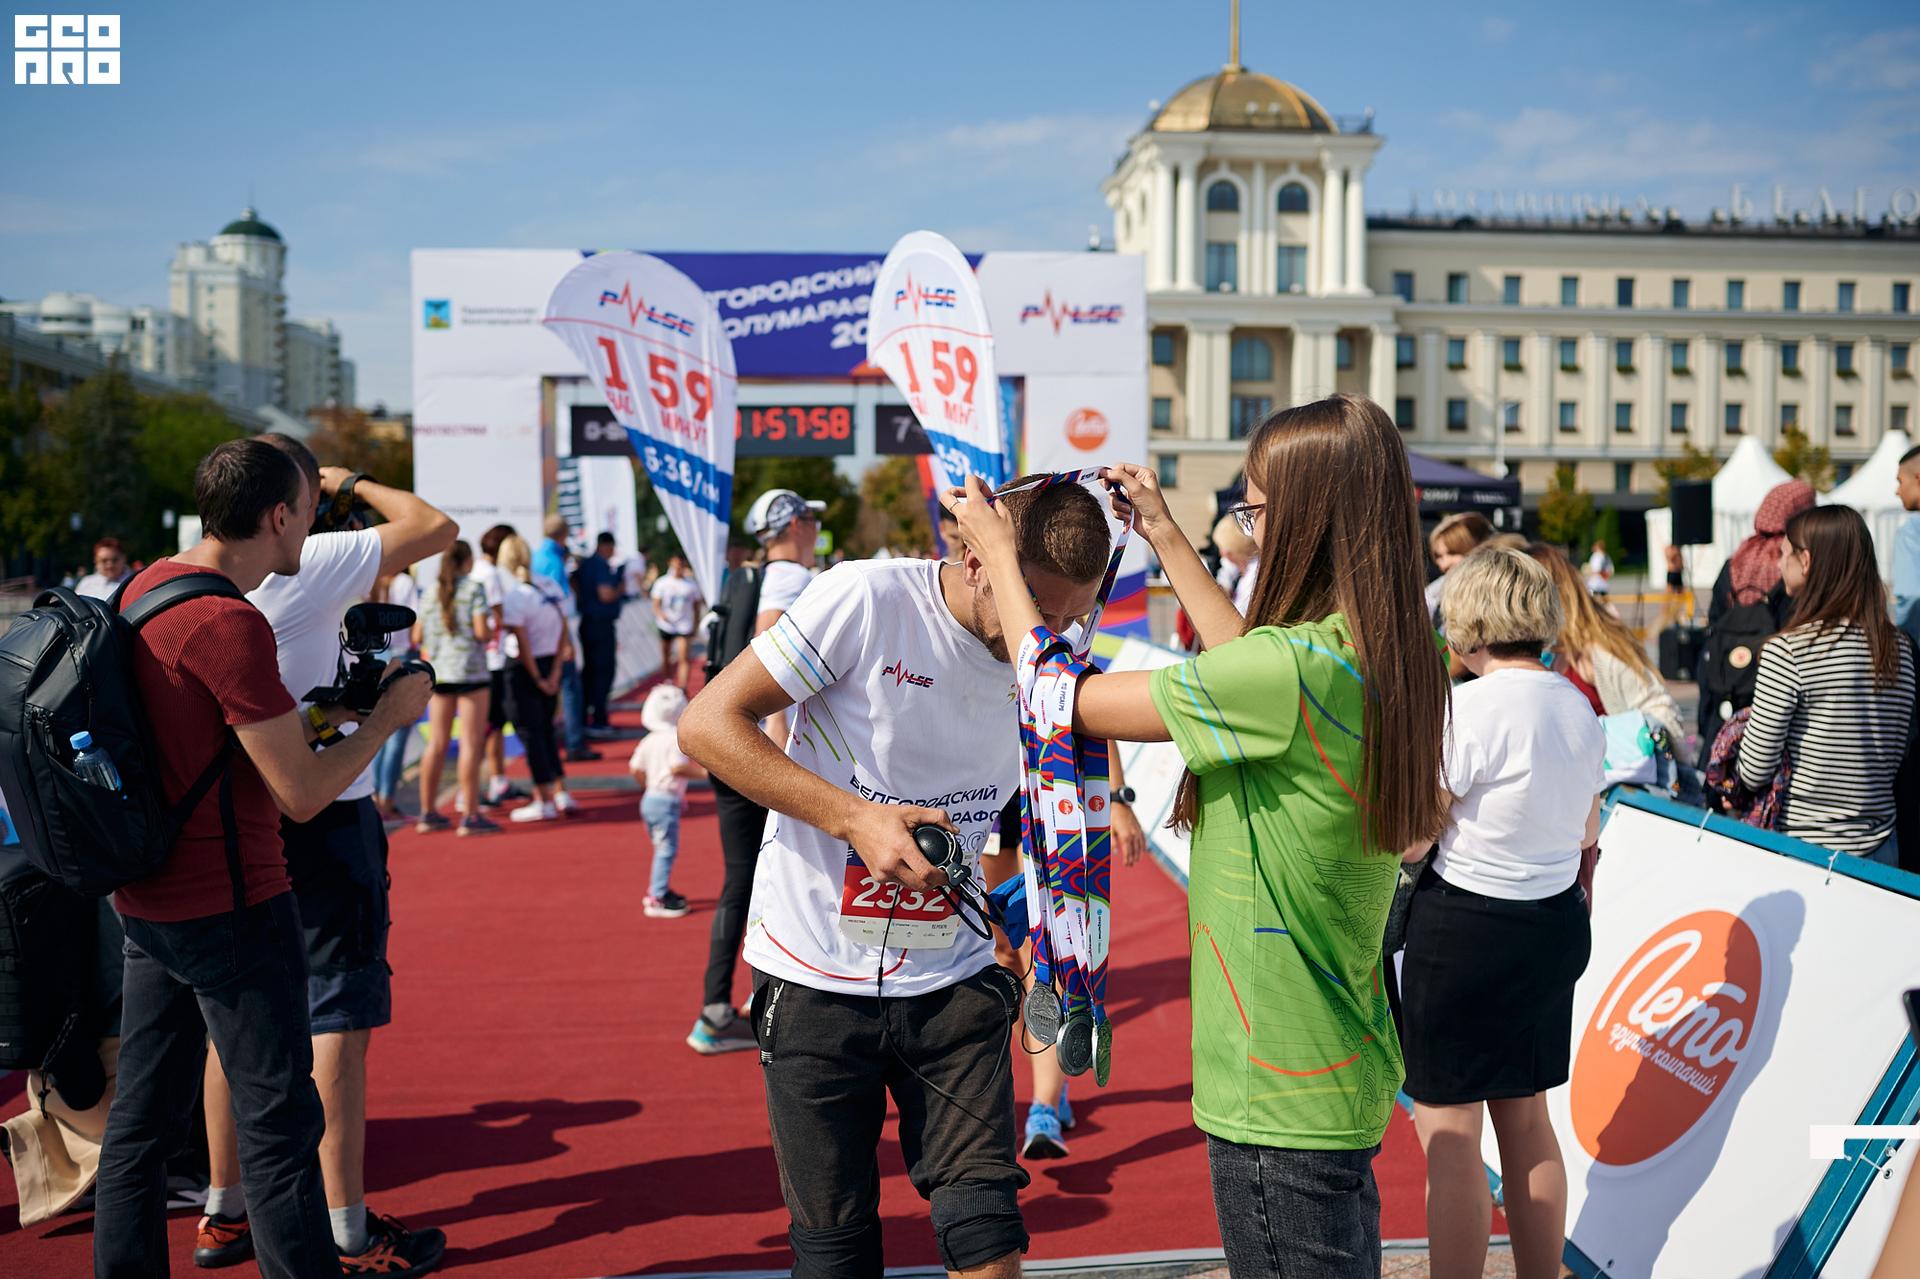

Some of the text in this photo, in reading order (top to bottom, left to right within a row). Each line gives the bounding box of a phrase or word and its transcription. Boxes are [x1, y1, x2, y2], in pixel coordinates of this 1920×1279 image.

[598, 336, 713, 423] 1 59
[899, 339, 978, 405] 1 59
[852, 876, 952, 912] 2332
[1597, 929, 1748, 1068] Лето
[1609, 1022, 1718, 1096] группа компаний
